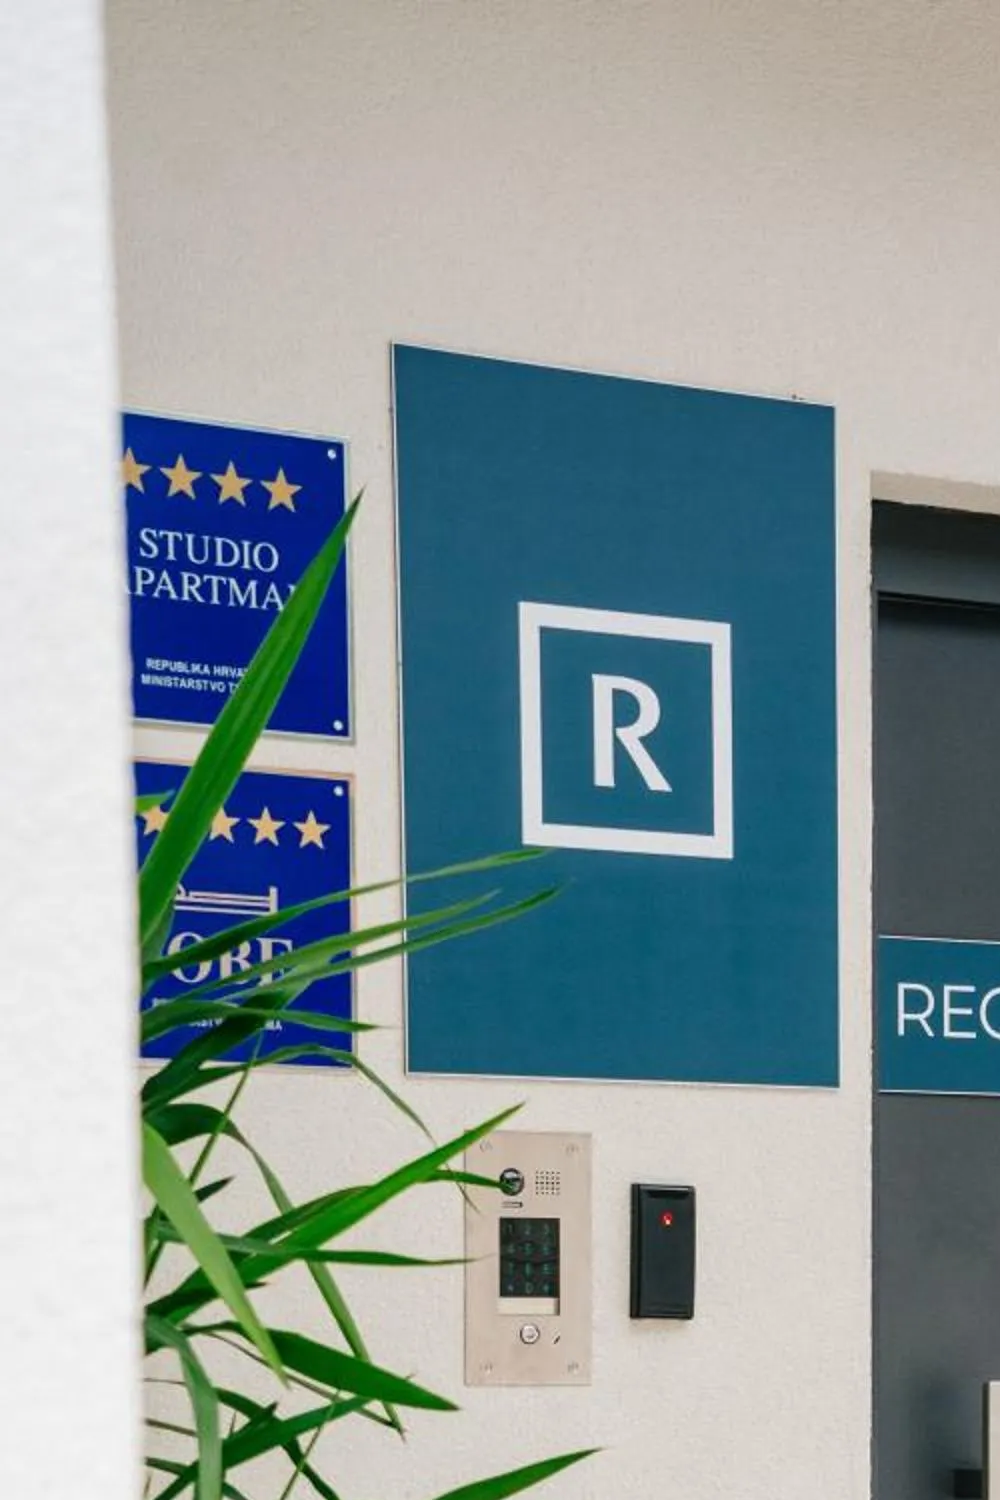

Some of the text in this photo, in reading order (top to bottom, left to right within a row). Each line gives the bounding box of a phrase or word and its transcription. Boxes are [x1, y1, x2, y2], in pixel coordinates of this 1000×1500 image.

[139, 527, 279, 573] STUDIO
[125, 565, 295, 611] PARTMA
[141, 673, 226, 693] MINISTARSTVO
[145, 657, 211, 676] REPUBLIKA
[592, 673, 673, 792] R
